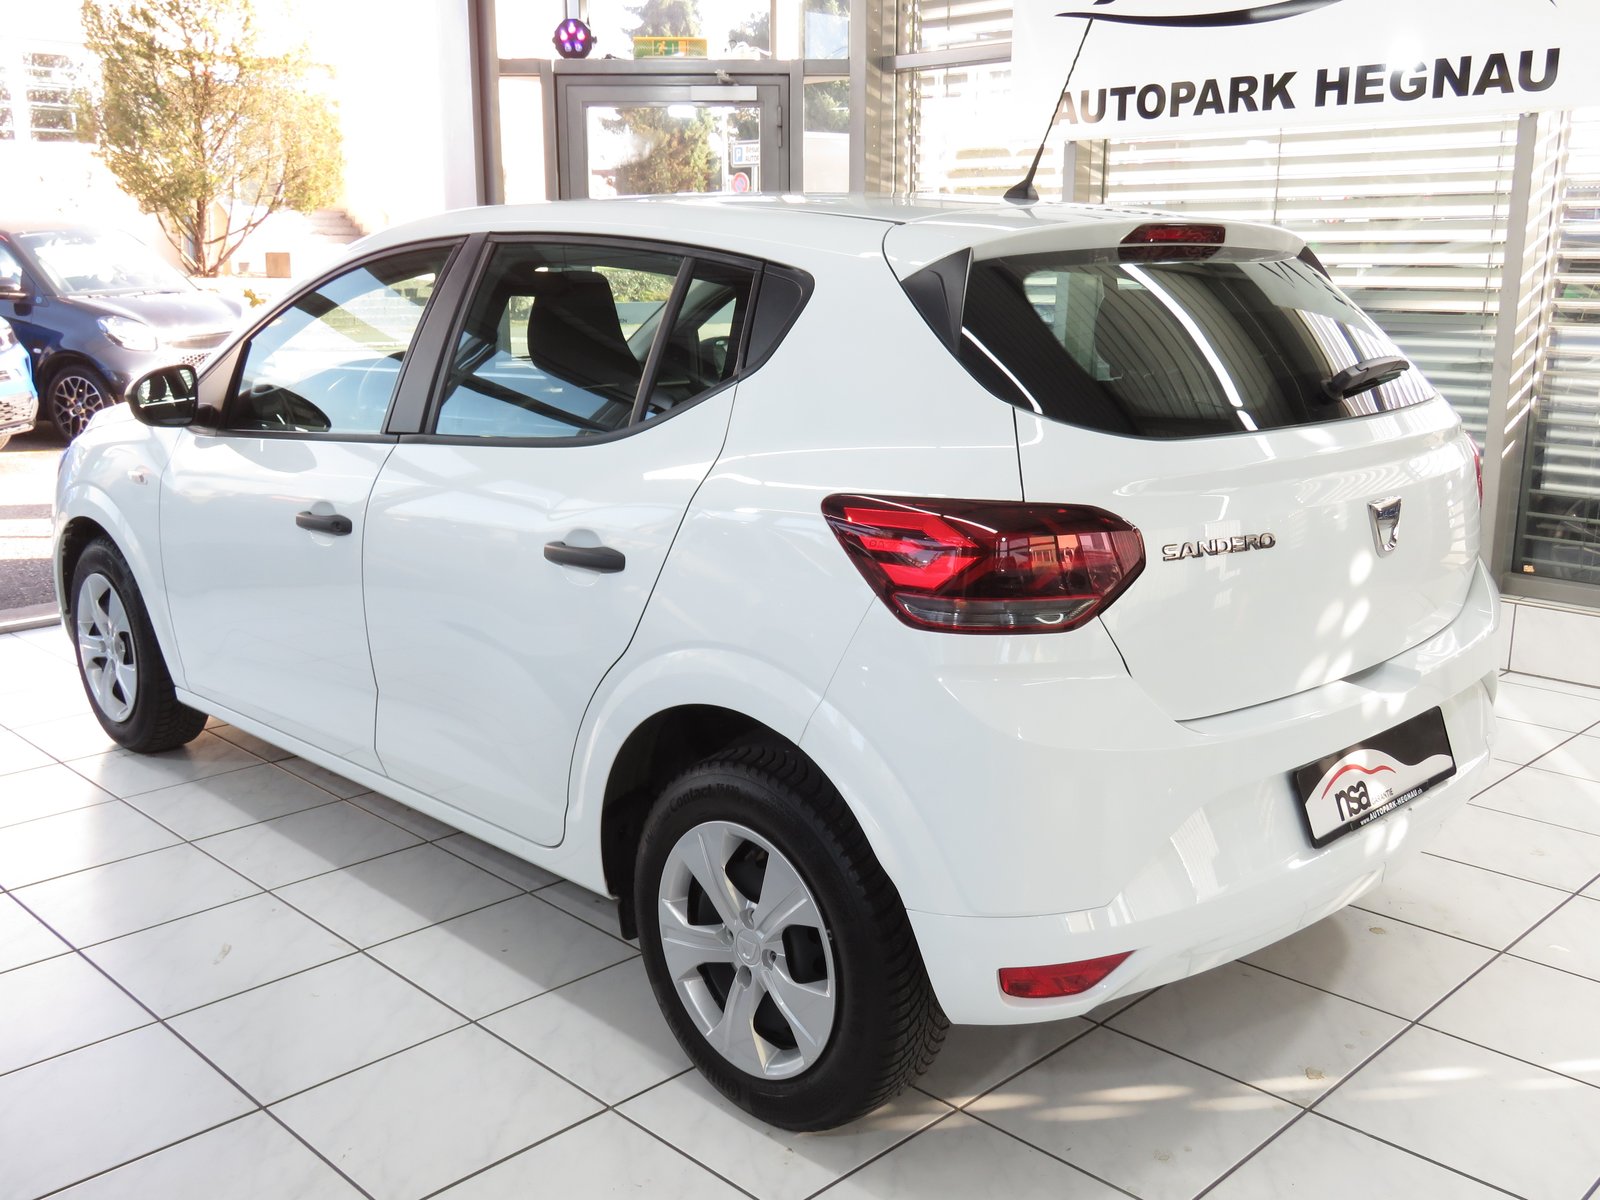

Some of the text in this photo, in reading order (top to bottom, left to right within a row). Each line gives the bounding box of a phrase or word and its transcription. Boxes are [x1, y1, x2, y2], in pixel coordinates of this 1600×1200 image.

[1052, 48, 1560, 125] AUTOPARK HEGNAU
[1161, 532, 1276, 562] SANDERO
[1334, 780, 1371, 822] nsa
[1360, 788, 1423, 826] www.AUTOPARK-HEGNAU.ch
